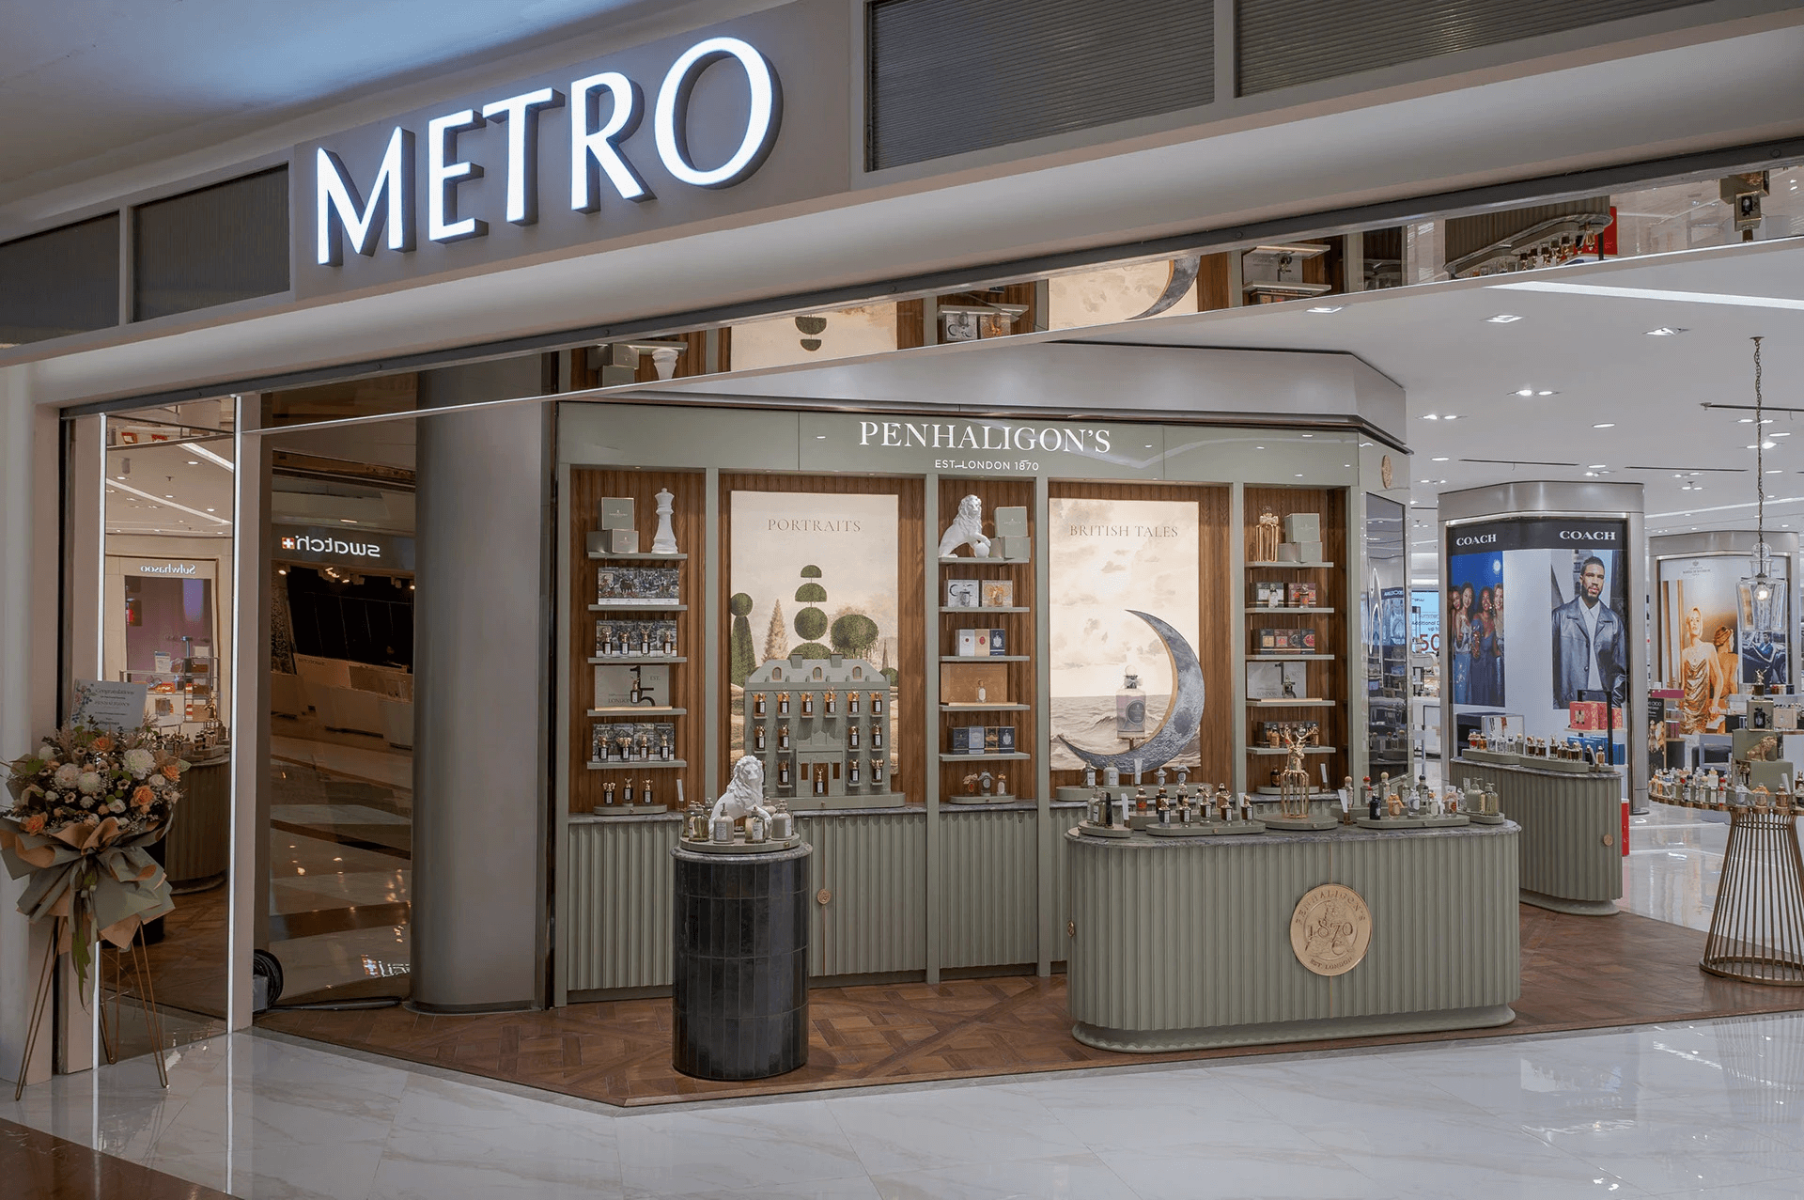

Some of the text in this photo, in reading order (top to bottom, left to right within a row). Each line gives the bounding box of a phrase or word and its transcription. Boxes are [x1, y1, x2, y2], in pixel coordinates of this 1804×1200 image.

[317, 37, 775, 266] METRO
[859, 421, 1111, 453] PENHALIGON'S
[962, 460, 1010, 470] LONDON
[1015, 461, 1039, 471] 1870
[768, 518, 861, 532] PORTRAITS
[1070, 524, 1178, 538] BRITISH TALES
[1456, 533, 1497, 546] COACH
[1559, 530, 1616, 540] COACH
